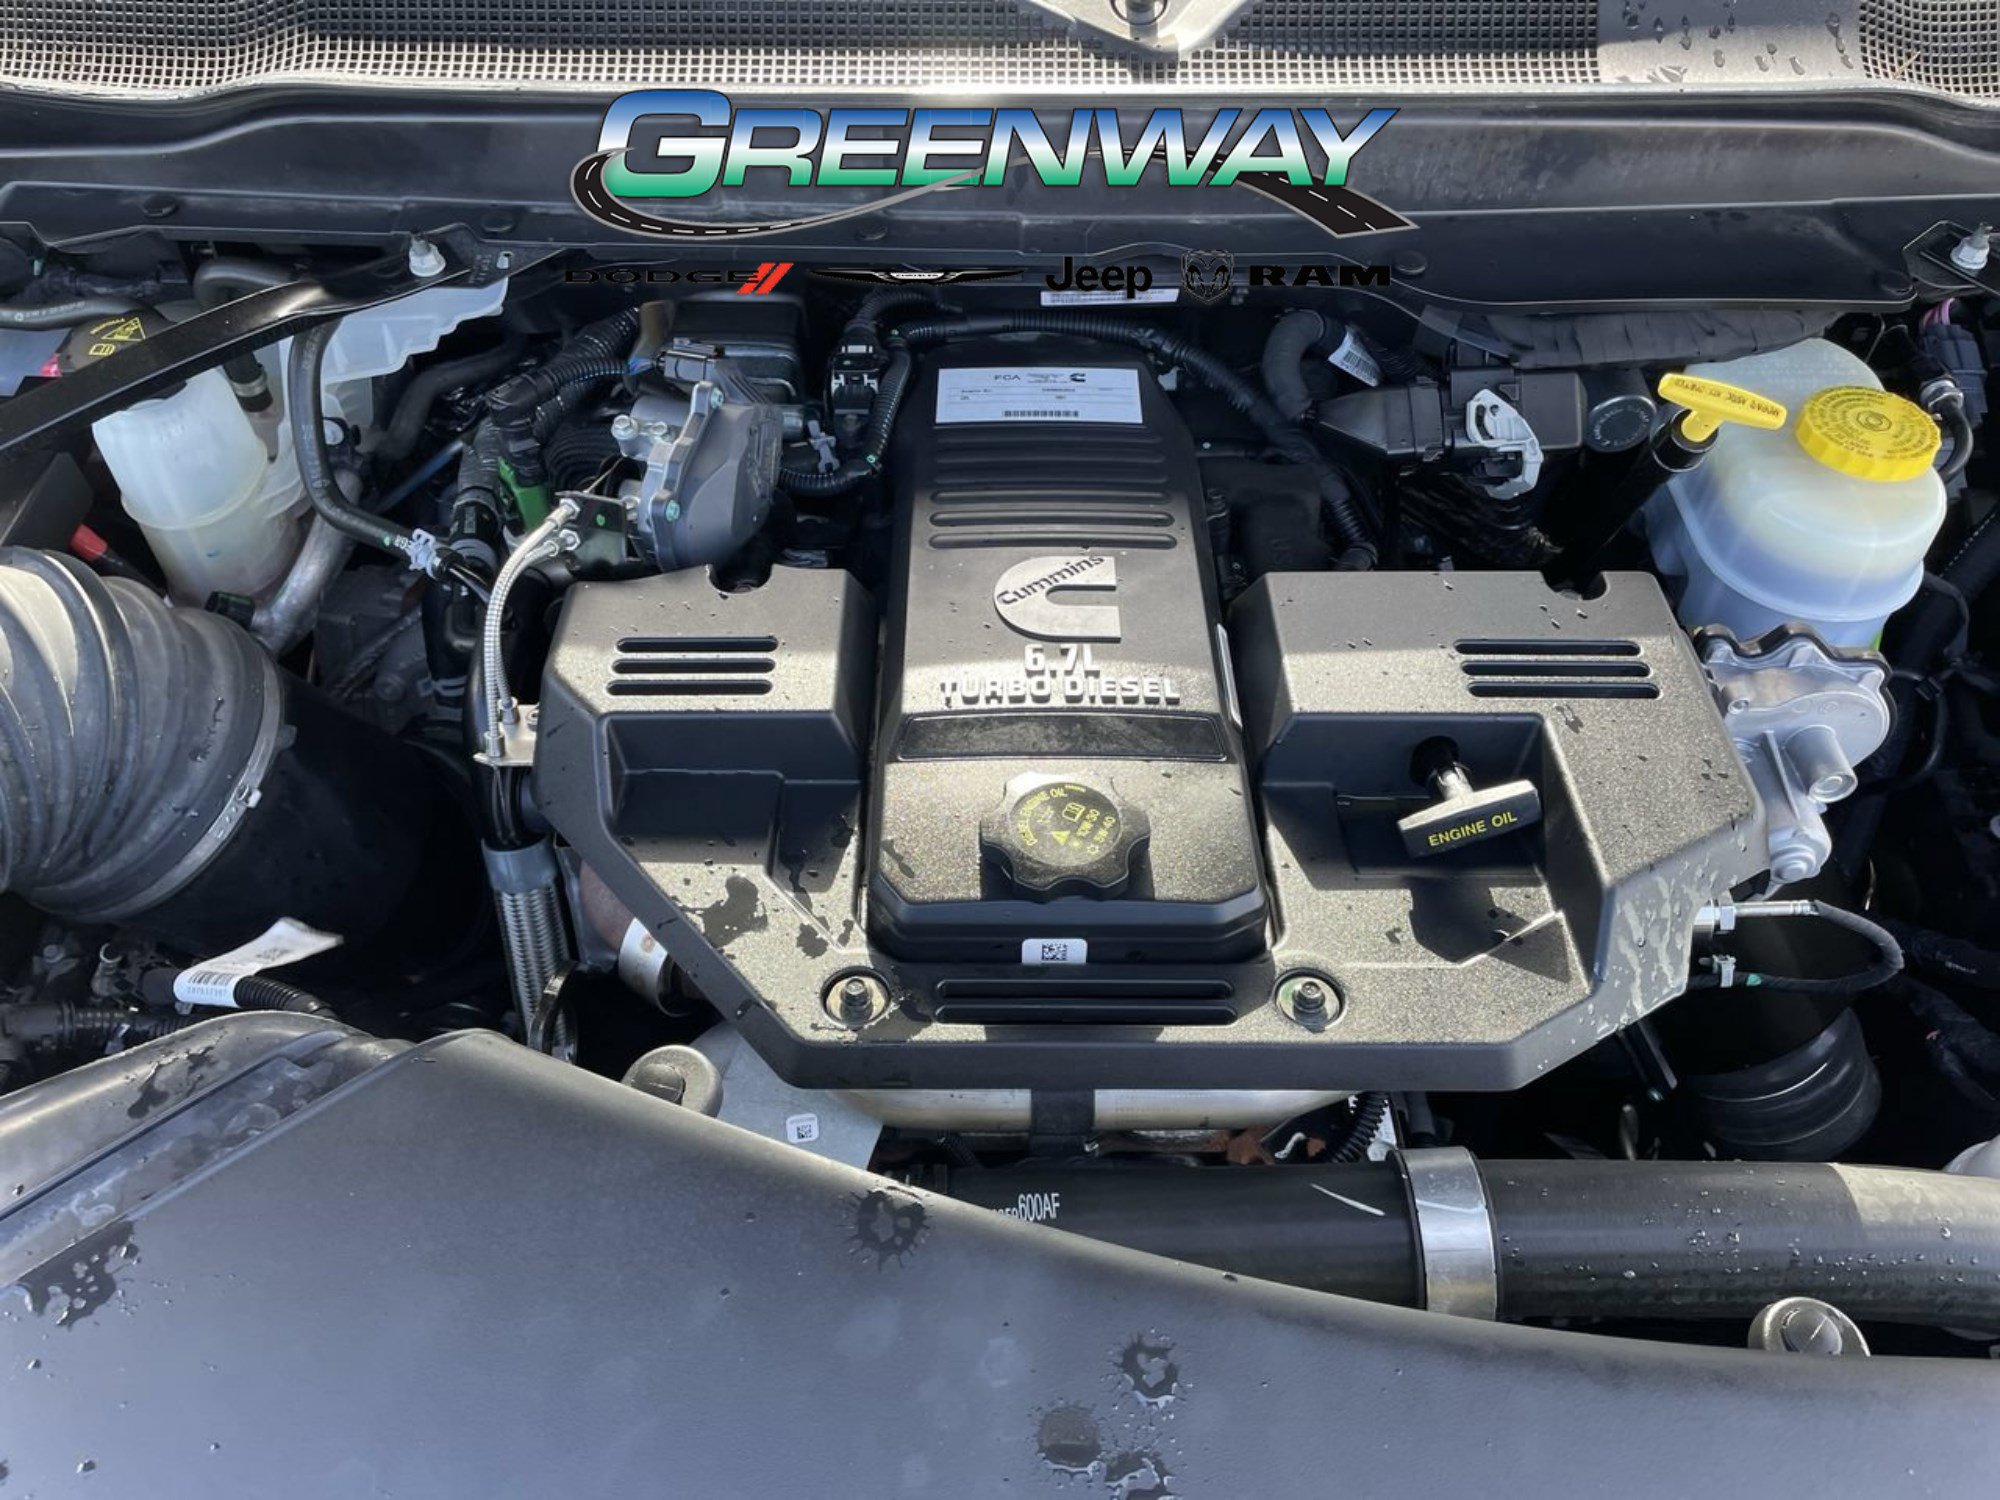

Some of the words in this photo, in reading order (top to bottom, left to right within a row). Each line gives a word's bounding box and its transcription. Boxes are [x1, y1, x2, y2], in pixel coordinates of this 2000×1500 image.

[996, 555, 1105, 606] Cummins
[1024, 643, 1101, 677] 6.7L
[940, 676, 1052, 706] TURBO
[1063, 676, 1181, 705] DIESEL
[1428, 821, 1487, 846] ENGINE
[1491, 811, 1518, 828] OIL
